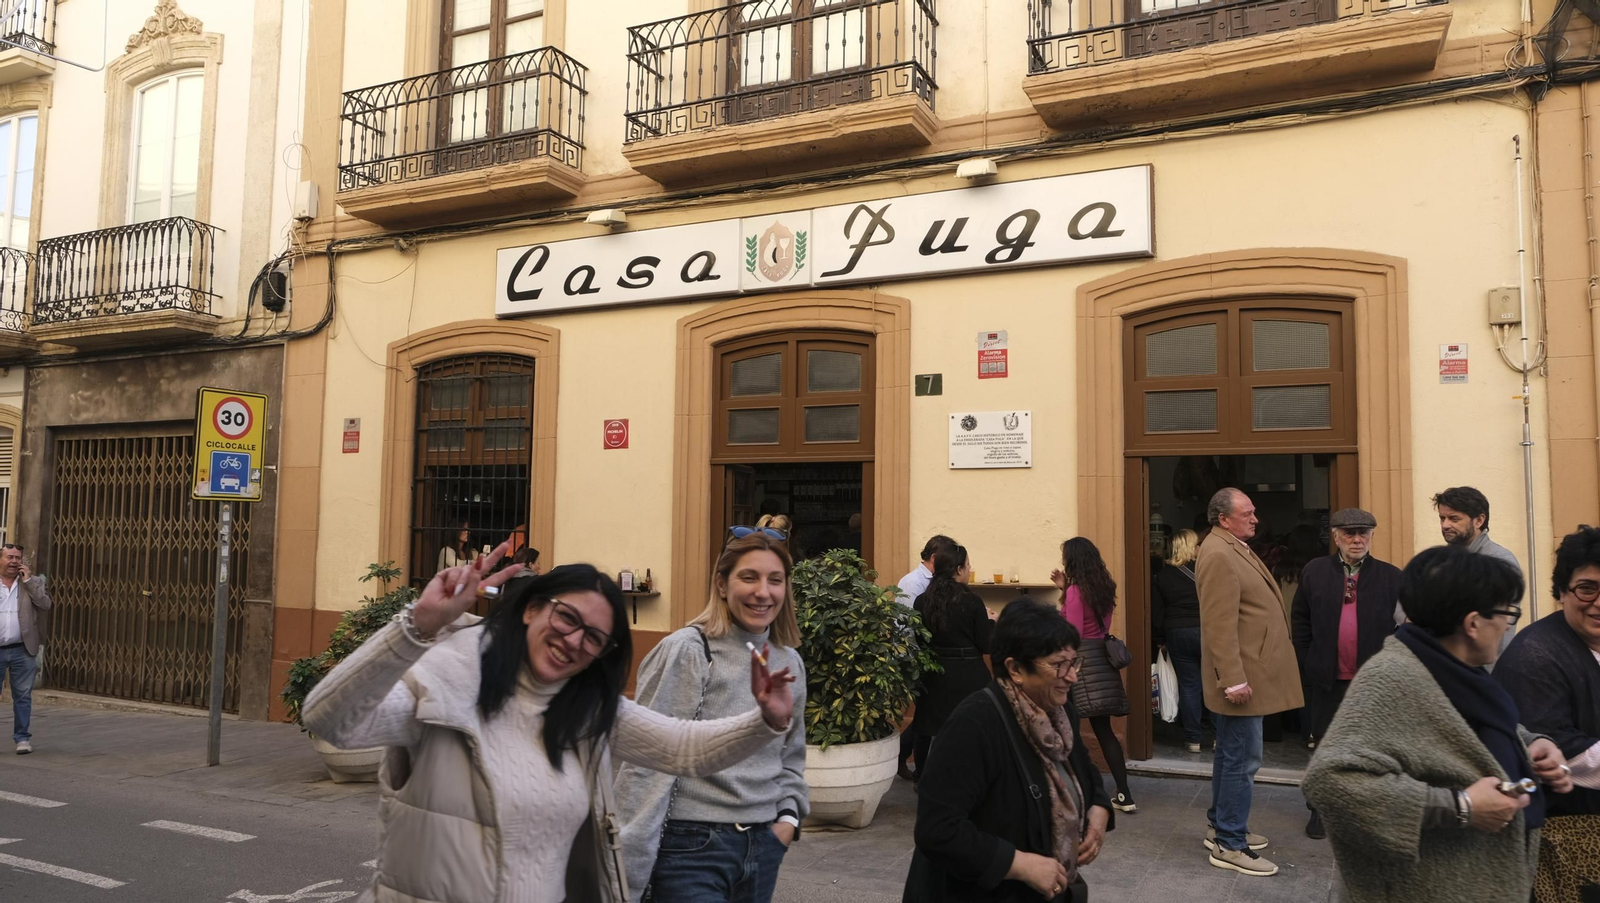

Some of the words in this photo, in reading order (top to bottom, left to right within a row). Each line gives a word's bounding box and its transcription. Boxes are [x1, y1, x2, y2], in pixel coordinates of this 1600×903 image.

[507, 245, 720, 302] Casa
[820, 202, 1125, 277] Puga
[923, 375, 934, 394] 7
[220, 410, 246, 427] 30
[206, 440, 256, 451] CICLOCALLE
